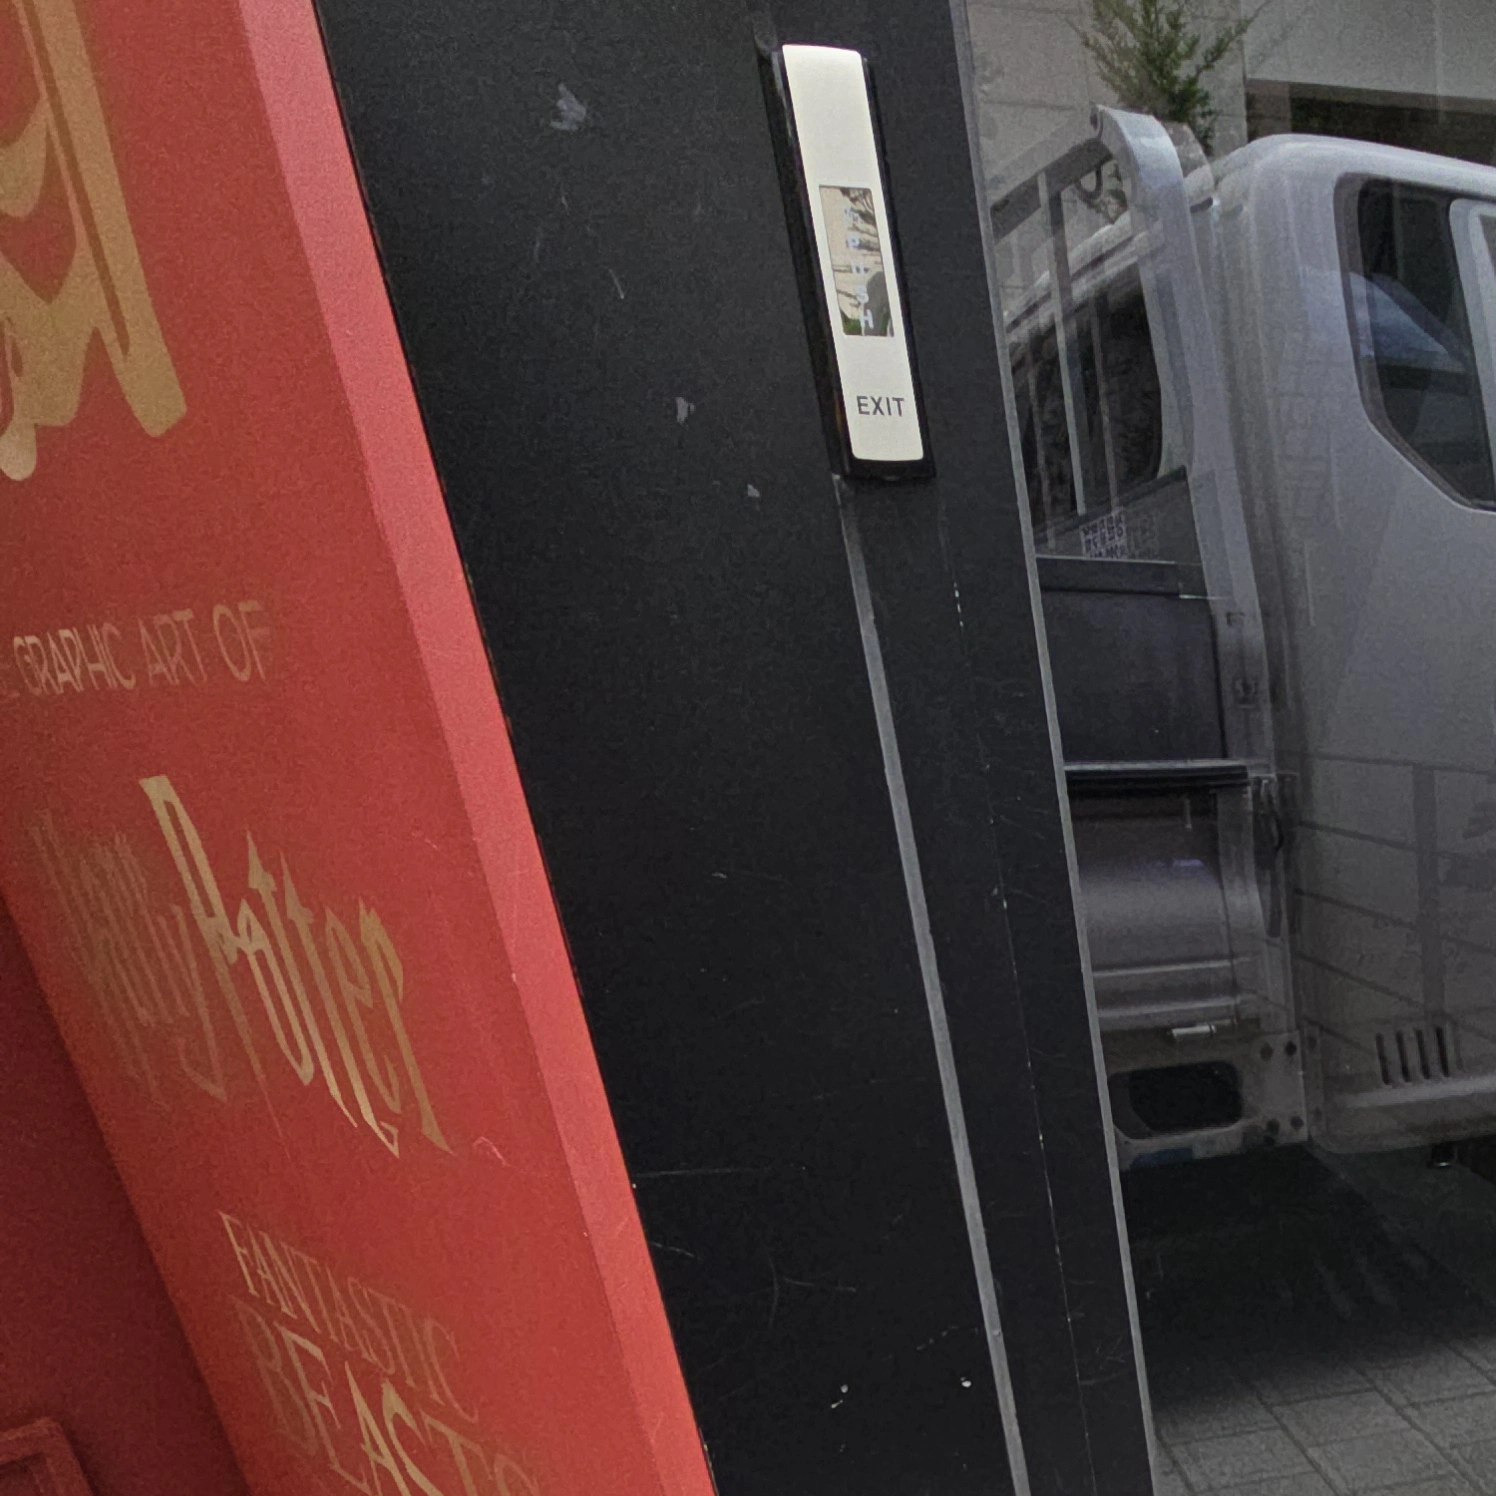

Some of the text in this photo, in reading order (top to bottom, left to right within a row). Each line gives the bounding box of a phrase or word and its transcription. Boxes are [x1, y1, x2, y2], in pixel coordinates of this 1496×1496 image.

[856, 395, 905, 418] EXIT
[13, 624, 136, 695] GRAPHIC
[137, 608, 208, 685] ART
[212, 600, 271, 683] OF
[139, 774, 458, 1158] Potter
[218, 1211, 479, 1423] FANTASTIC
